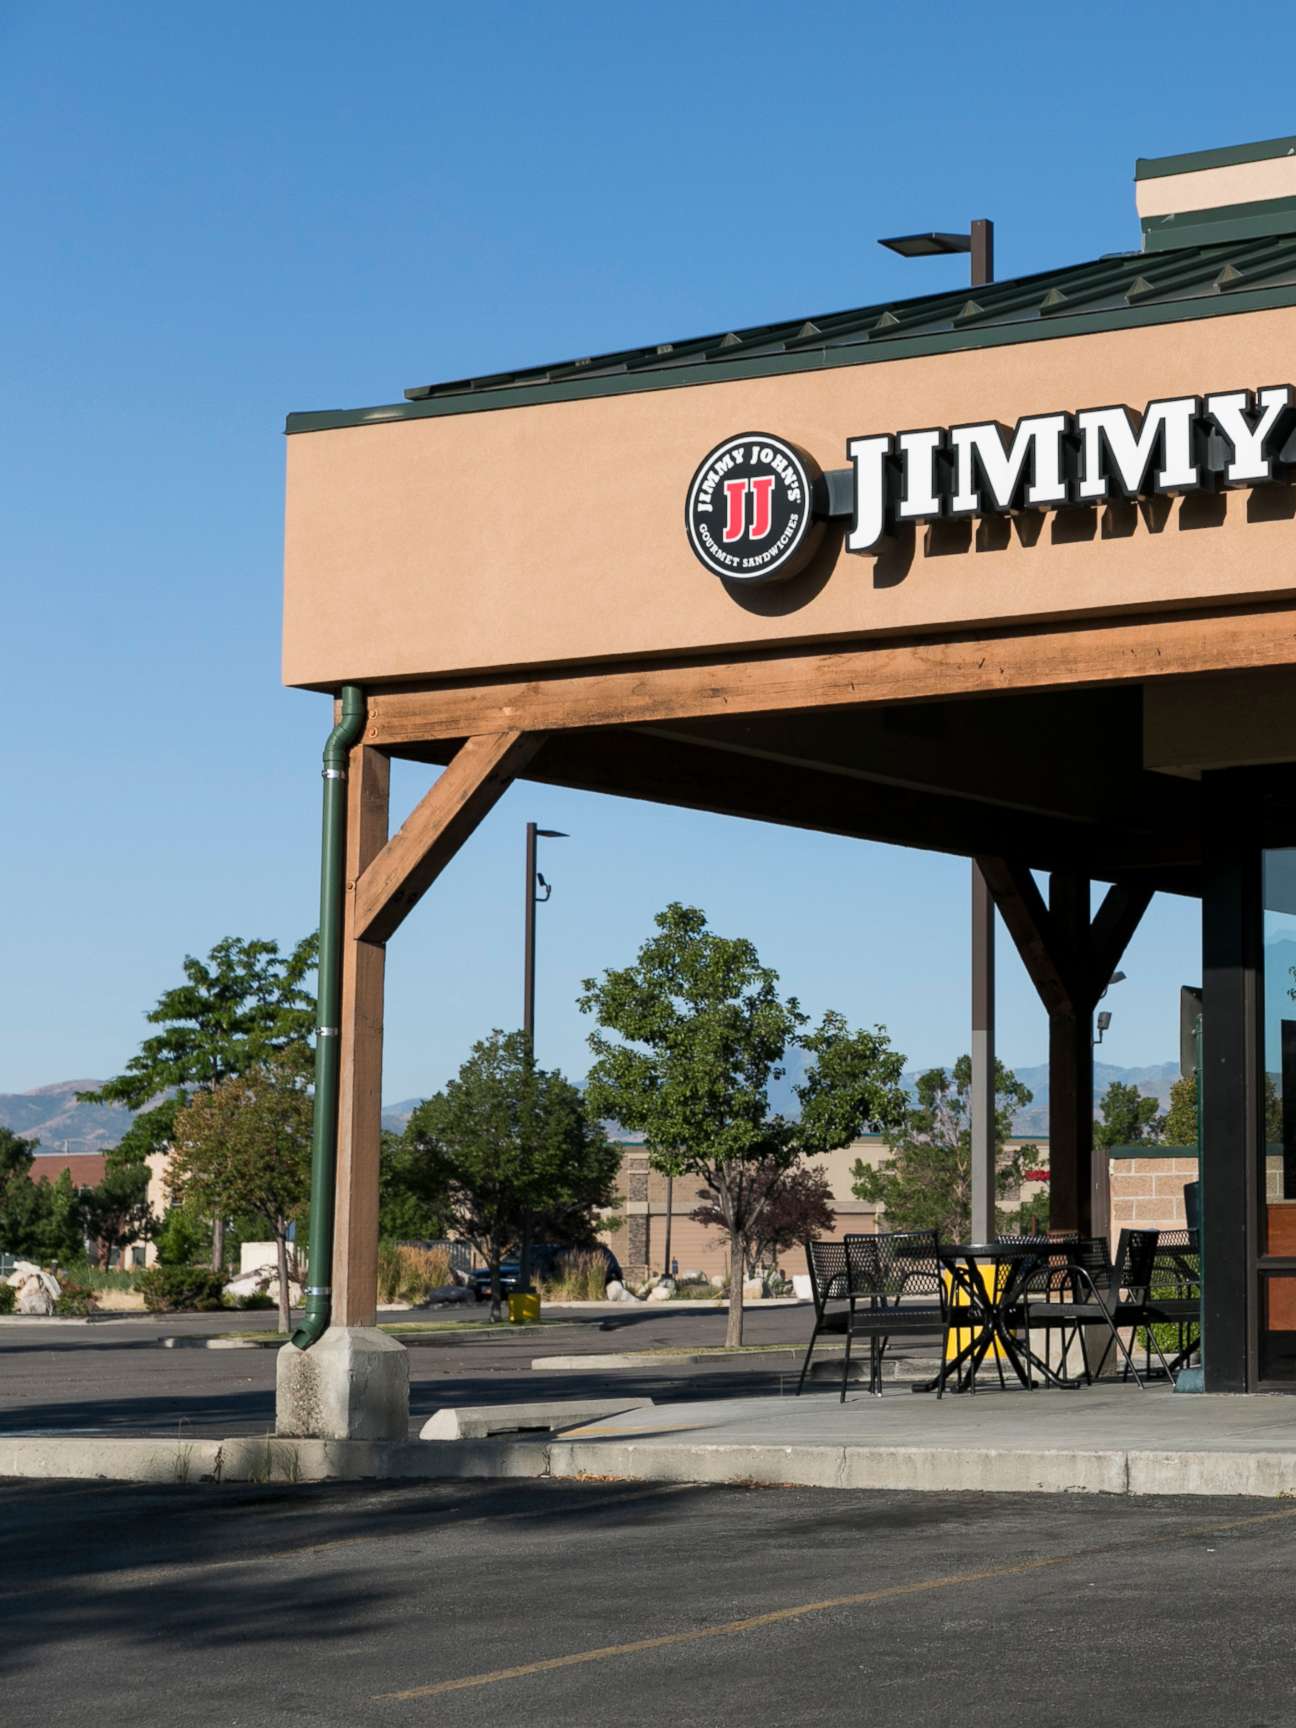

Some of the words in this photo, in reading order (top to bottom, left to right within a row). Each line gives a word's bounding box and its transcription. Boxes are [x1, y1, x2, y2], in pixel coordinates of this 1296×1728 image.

[698, 447, 745, 512] JIMMY
[750, 446, 801, 503] JOHN'S
[847, 384, 1294, 552] JIMMY
[700, 523, 740, 567] GOURMET
[742, 513, 798, 567] SANDWICHES
[723, 475, 775, 542] JJ
